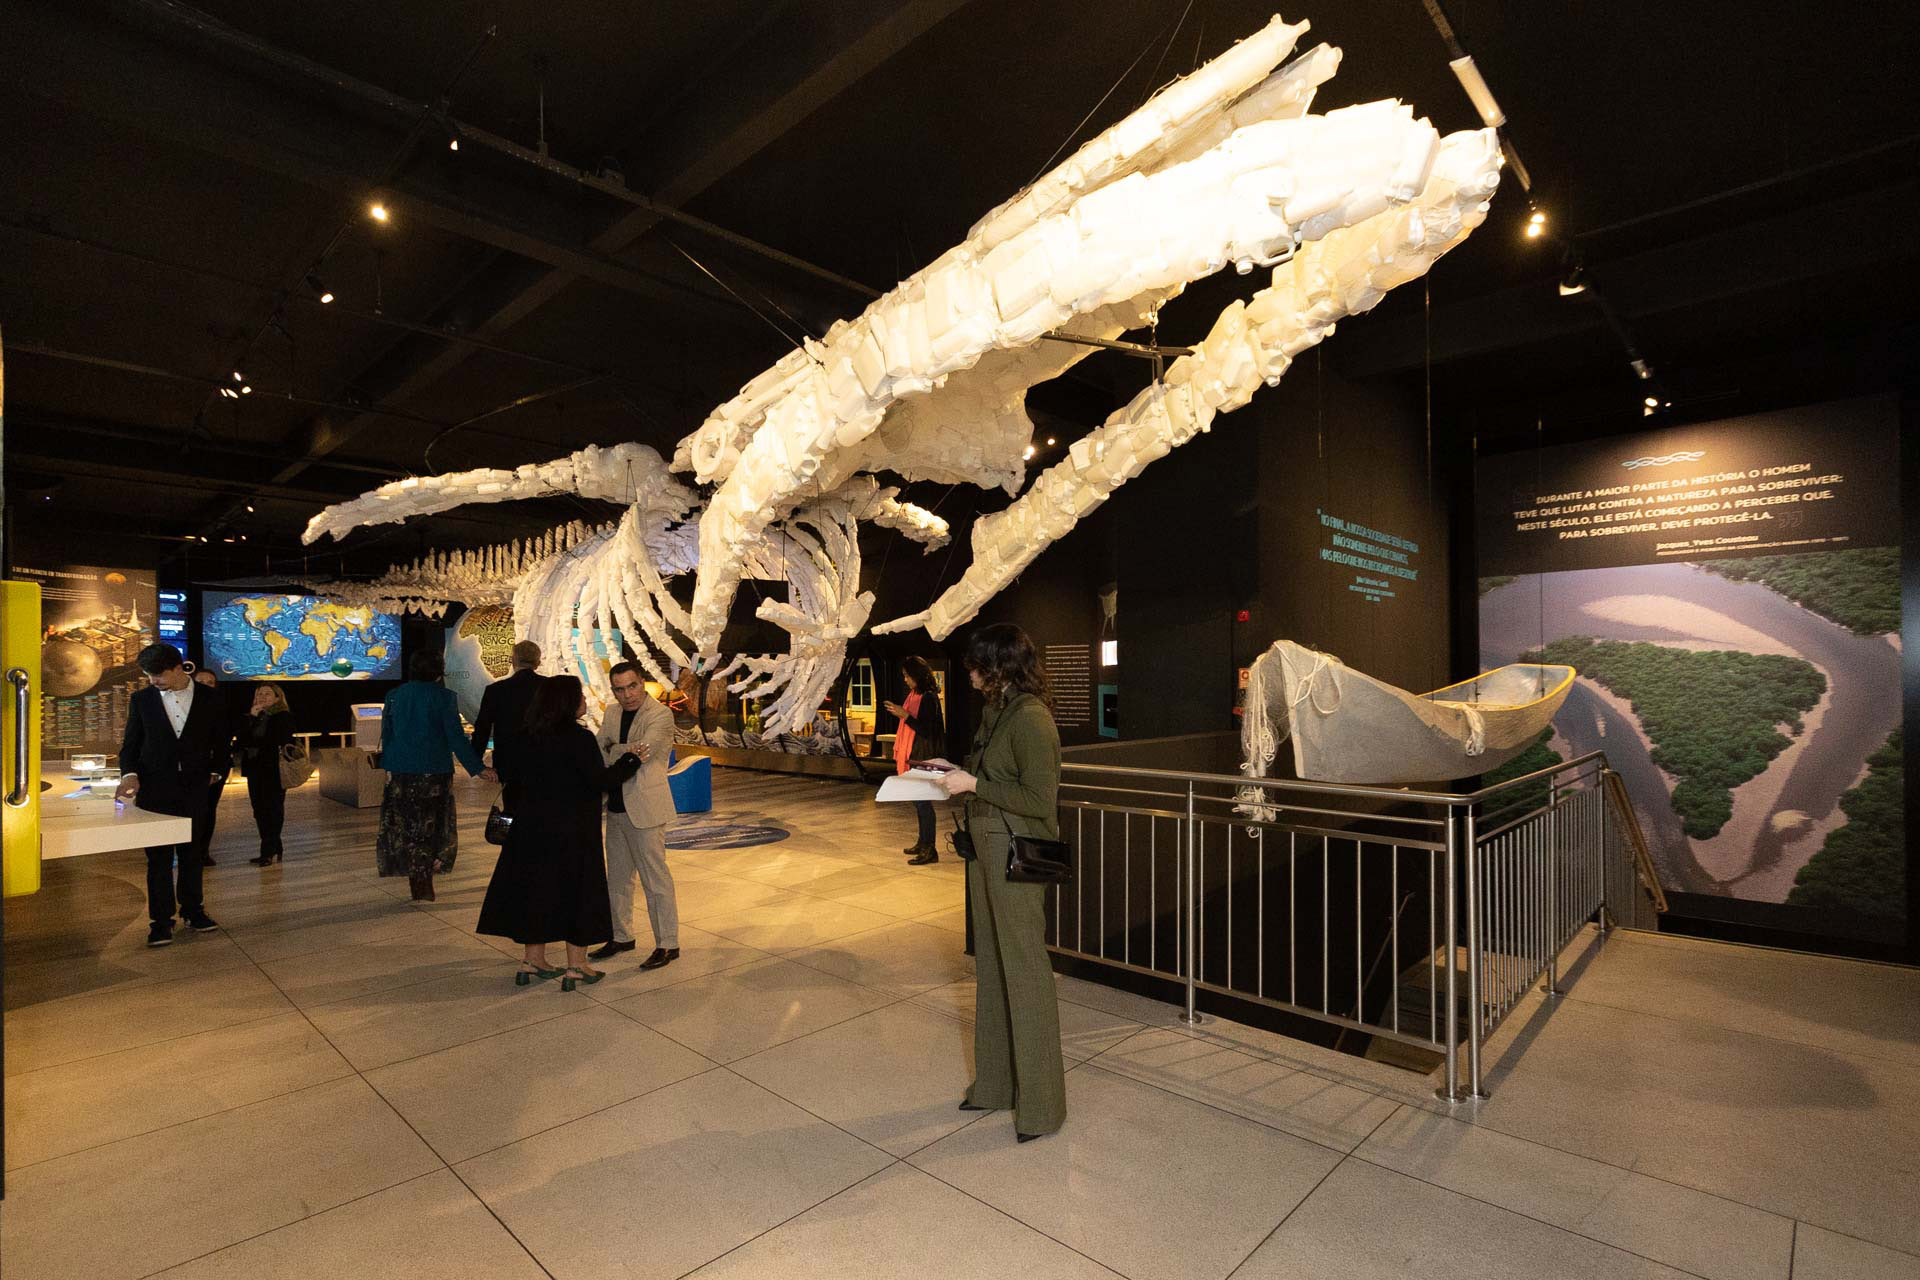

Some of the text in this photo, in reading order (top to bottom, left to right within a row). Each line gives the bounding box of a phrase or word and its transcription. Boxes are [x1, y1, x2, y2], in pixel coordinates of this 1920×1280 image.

[1513, 510, 1538, 519] TEVE
[1539, 507, 1560, 517] QUE
[1562, 502, 1597, 514] LUTAR
[1598, 497, 1643, 510] CONTRA
[1645, 496, 1655, 505] A
[1656, 488, 1718, 503] NATUREZA
[1720, 484, 1756, 496] PARA
[1536, 463, 1811, 504] DURANTE A MAIOR PARTE DA HISTÓRIA O HOMEM
[1516, 521, 1548, 532] NESTE
[1593, 514, 1614, 524] ELE
[1615, 509, 1644, 521] ESTÁ
[1644, 502, 1720, 518] COMEÇANDO
[1722, 501, 1732, 509] A
[1734, 493, 1800, 509] PERCEBER
[1559, 529, 1589, 540] PARA
[1660, 519, 1691, 529] DEVE
